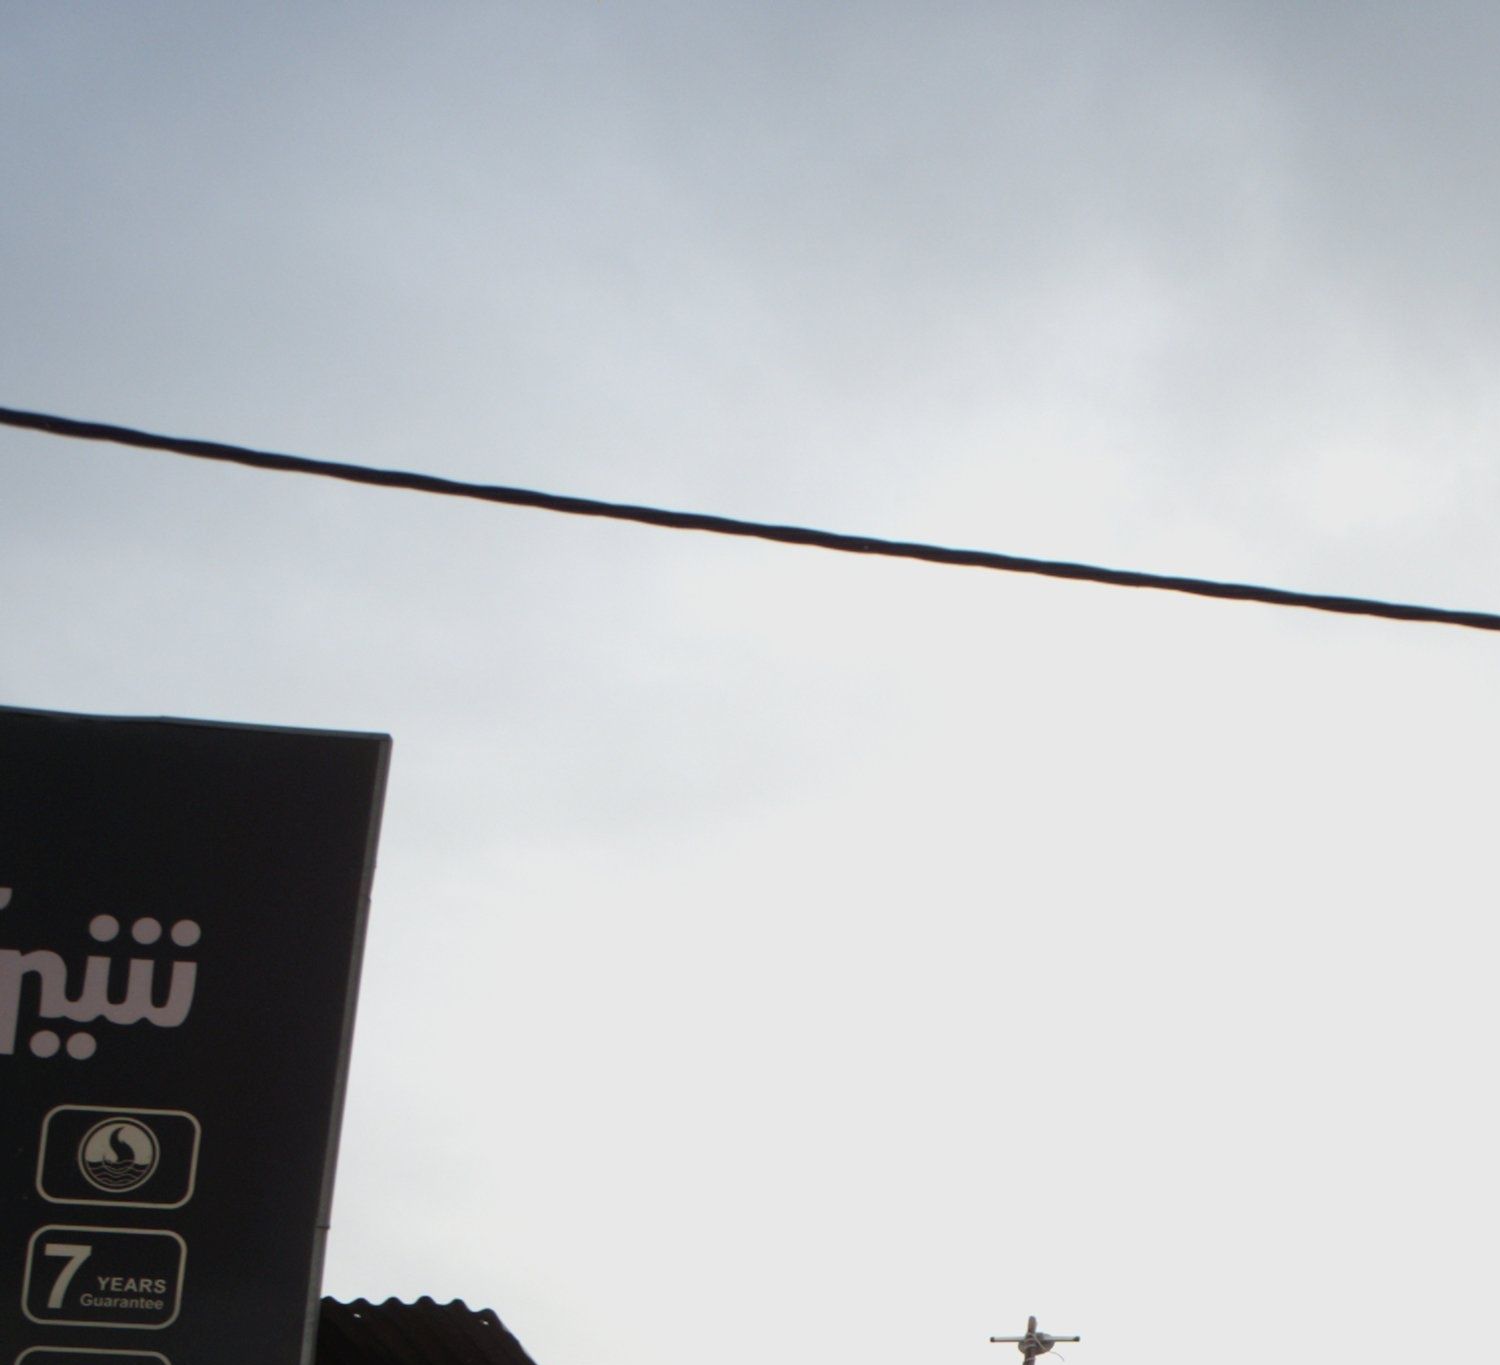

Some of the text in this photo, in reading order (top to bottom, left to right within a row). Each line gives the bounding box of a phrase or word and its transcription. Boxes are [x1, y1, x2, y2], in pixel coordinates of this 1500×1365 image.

[45, 1243, 167, 1309] 7 YEARS
[80, 1293, 164, 1310] Guarantee
